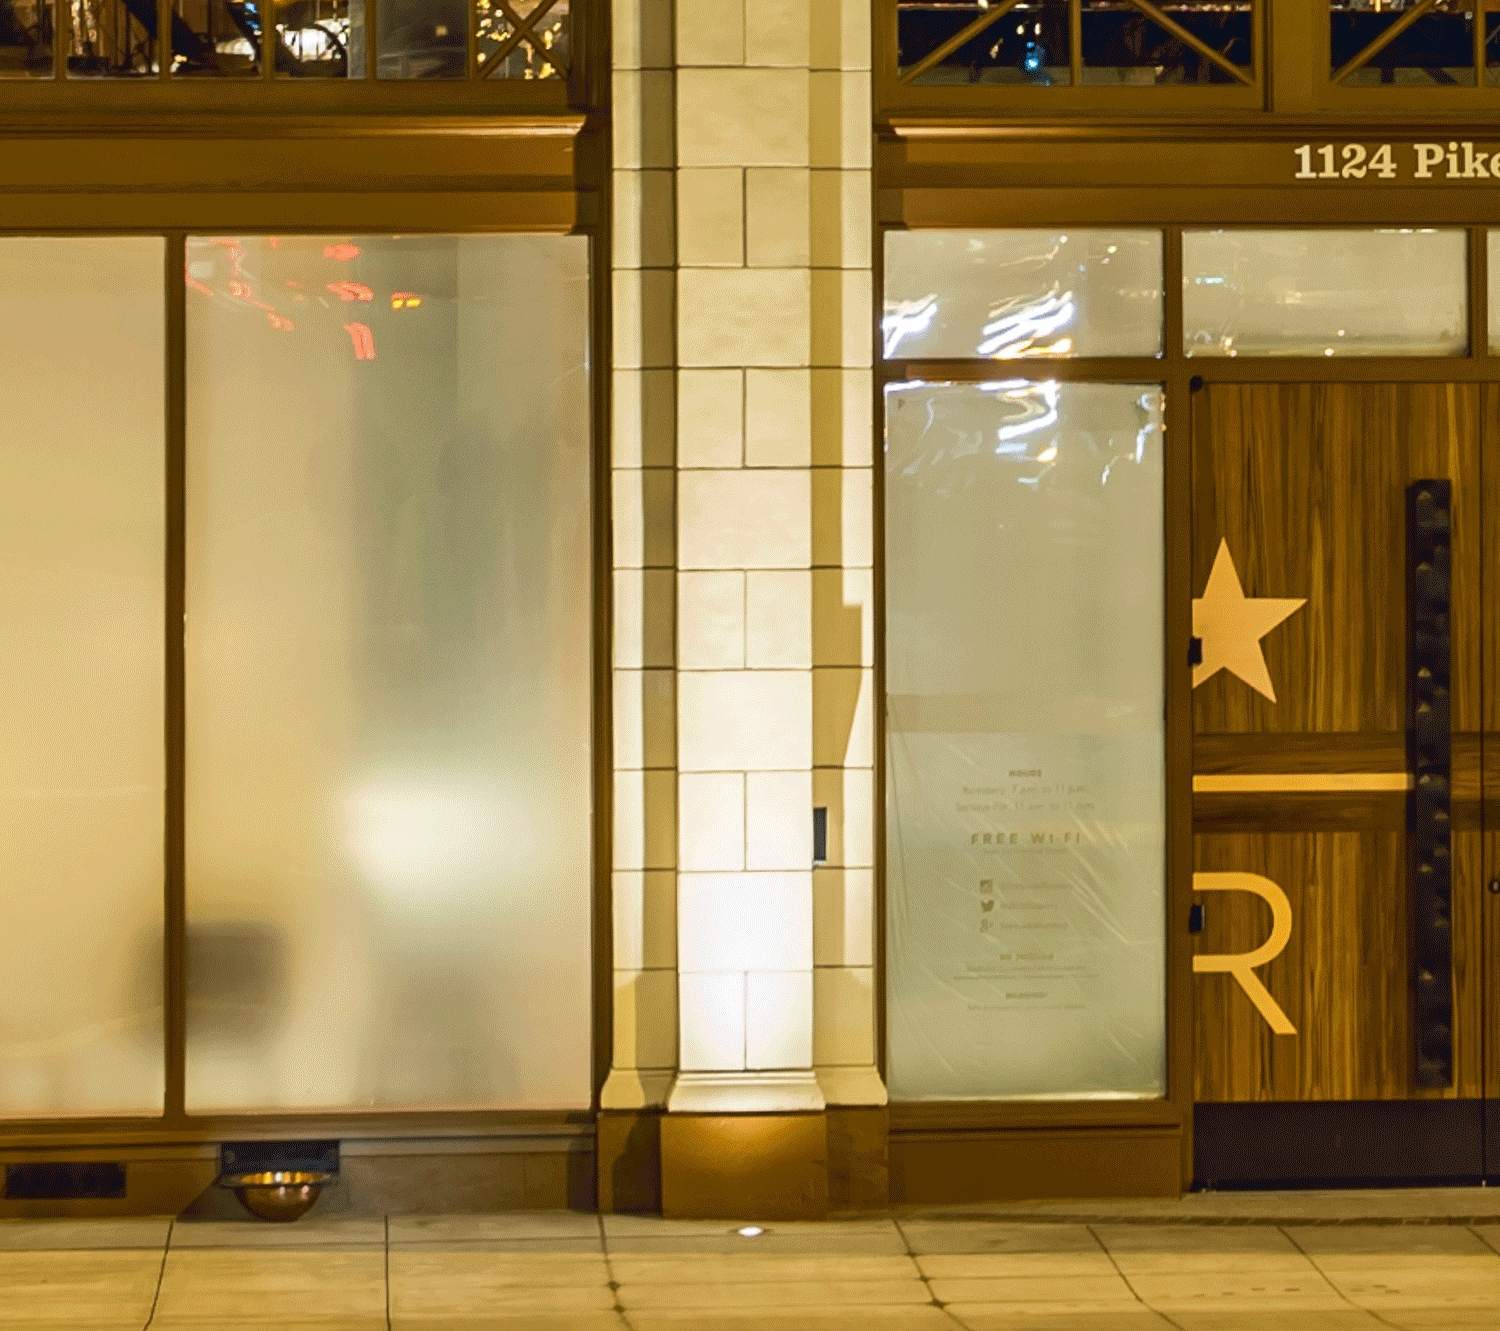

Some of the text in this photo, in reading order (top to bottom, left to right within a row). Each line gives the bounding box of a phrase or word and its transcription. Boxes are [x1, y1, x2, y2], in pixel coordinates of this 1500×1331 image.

[1294, 143, 1397, 179] 1124
[970, 832, 1080, 845] FREE WI-FI
